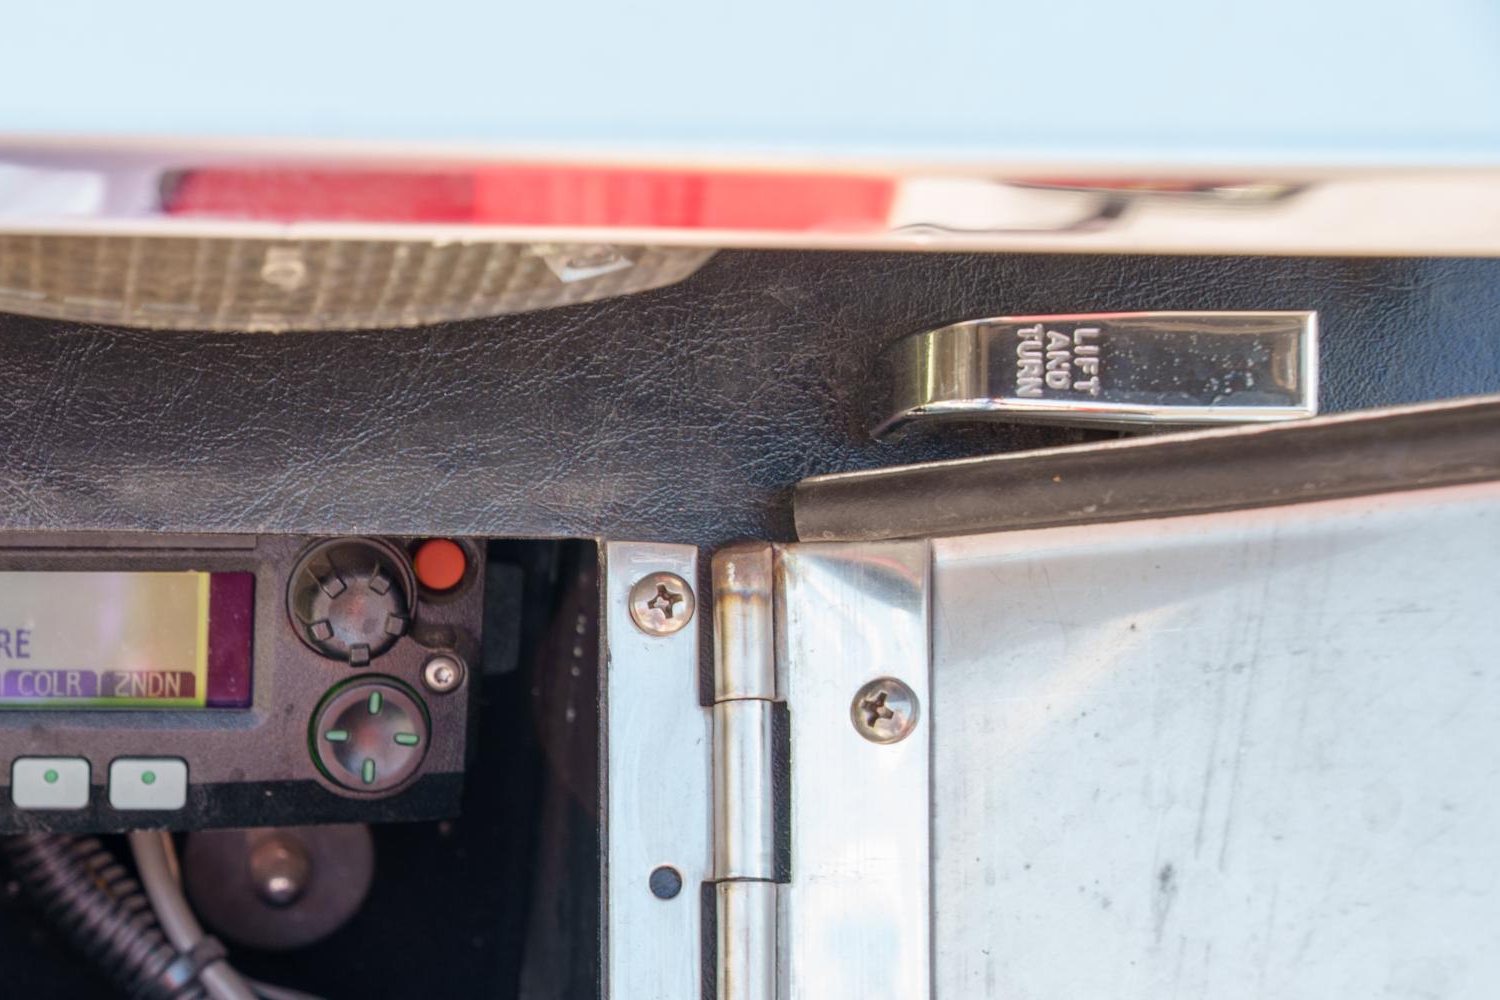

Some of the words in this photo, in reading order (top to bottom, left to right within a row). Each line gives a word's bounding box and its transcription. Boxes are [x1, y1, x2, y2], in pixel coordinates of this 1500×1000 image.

[1015, 322, 1044, 397] TURN
[1045, 329, 1071, 390] AND
[1073, 327, 1100, 397] LIFT
[17, 671, 83, 698] COLR
